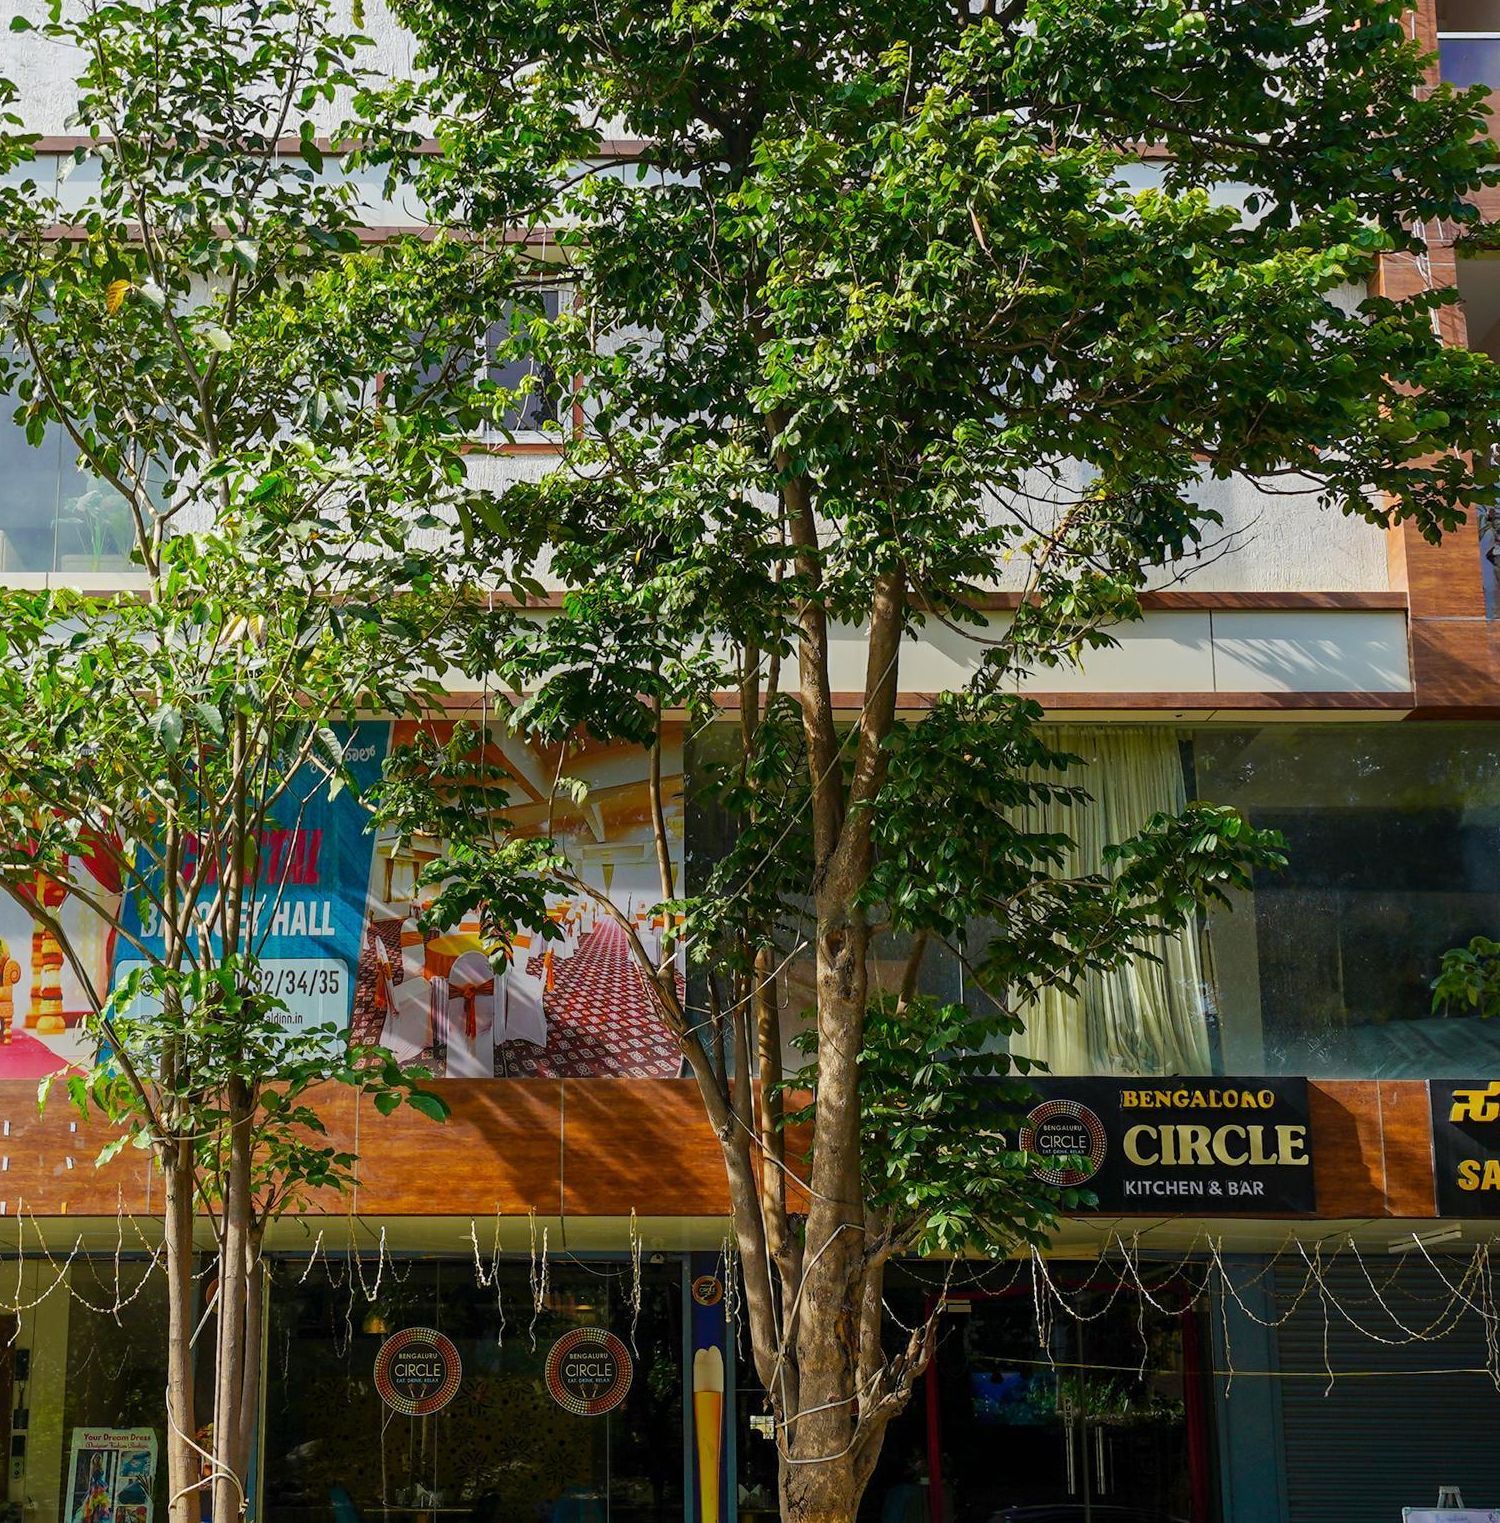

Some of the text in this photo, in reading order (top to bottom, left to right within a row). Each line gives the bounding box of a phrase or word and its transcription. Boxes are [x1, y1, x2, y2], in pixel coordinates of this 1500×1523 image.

[272, 900, 335, 936] HALL
[1040, 1135, 1087, 1149] CIRCLE
[1123, 1125, 1310, 1166] CIRCLE
[1125, 1180, 1265, 1196] KITCHEN & BAR
[394, 1363, 442, 1377] CIRCLE
[565, 1363, 613, 1377] CIRCLE
[84, 1433, 101, 1441] Your
[104, 1433, 129, 1441] Dream
